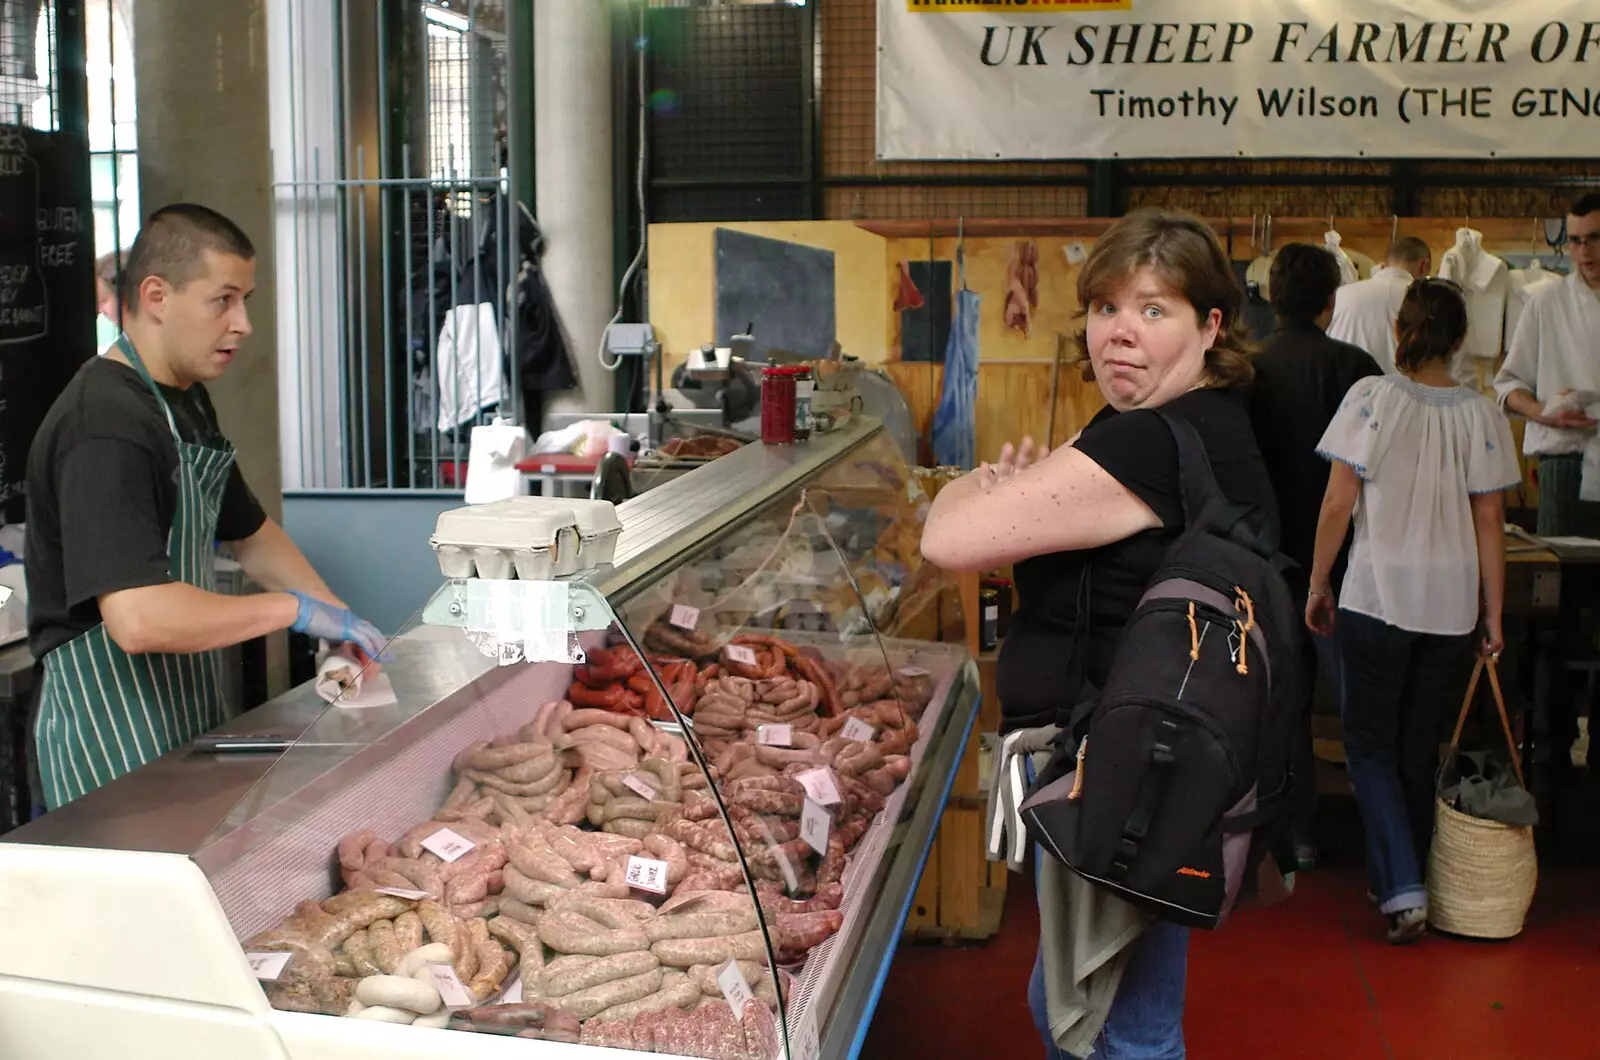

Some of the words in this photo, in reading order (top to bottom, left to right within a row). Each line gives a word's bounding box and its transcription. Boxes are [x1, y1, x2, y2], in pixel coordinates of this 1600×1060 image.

[980, 24, 1055, 66] UK
[1066, 22, 1254, 66] SHEEP
[1269, 21, 1510, 64] FARMER
[1090, 86, 1239, 125] Timothy
[1256, 86, 1378, 118] Wilson
[1398, 86, 1492, 123] (THE
[40, 242, 78, 266] FREE
